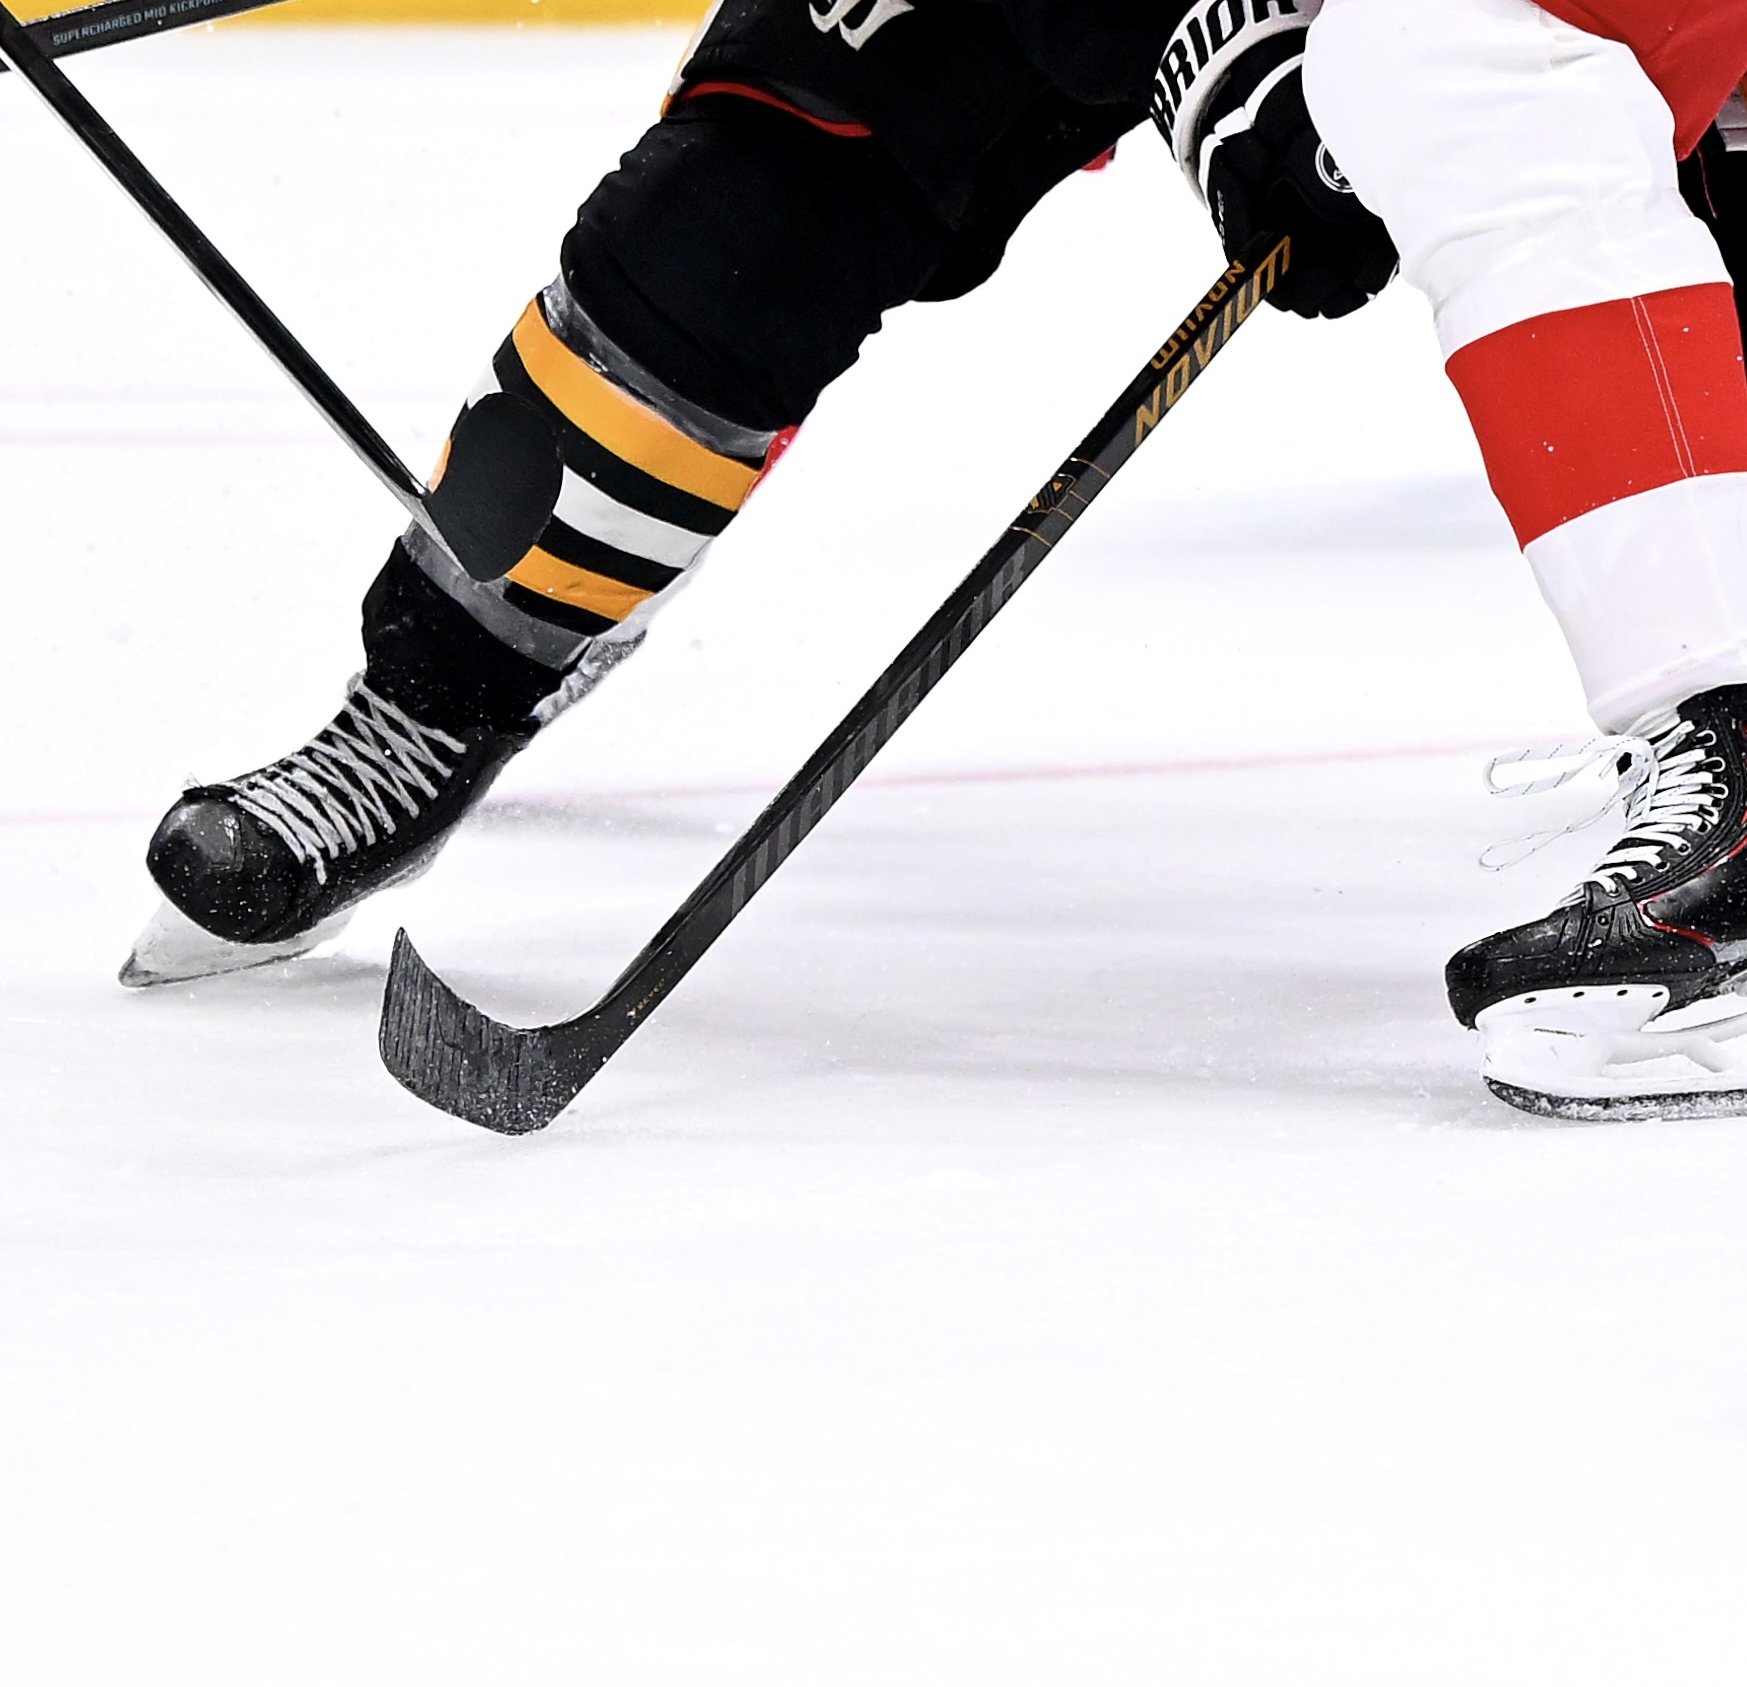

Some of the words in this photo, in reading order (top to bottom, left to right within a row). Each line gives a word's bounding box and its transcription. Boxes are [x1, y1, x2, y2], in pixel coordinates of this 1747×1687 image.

[52, 12, 142, 46] SUPERCHARGED
[144, 6, 167, 23] MID
[1135, 234, 1292, 448] NOVIUM
